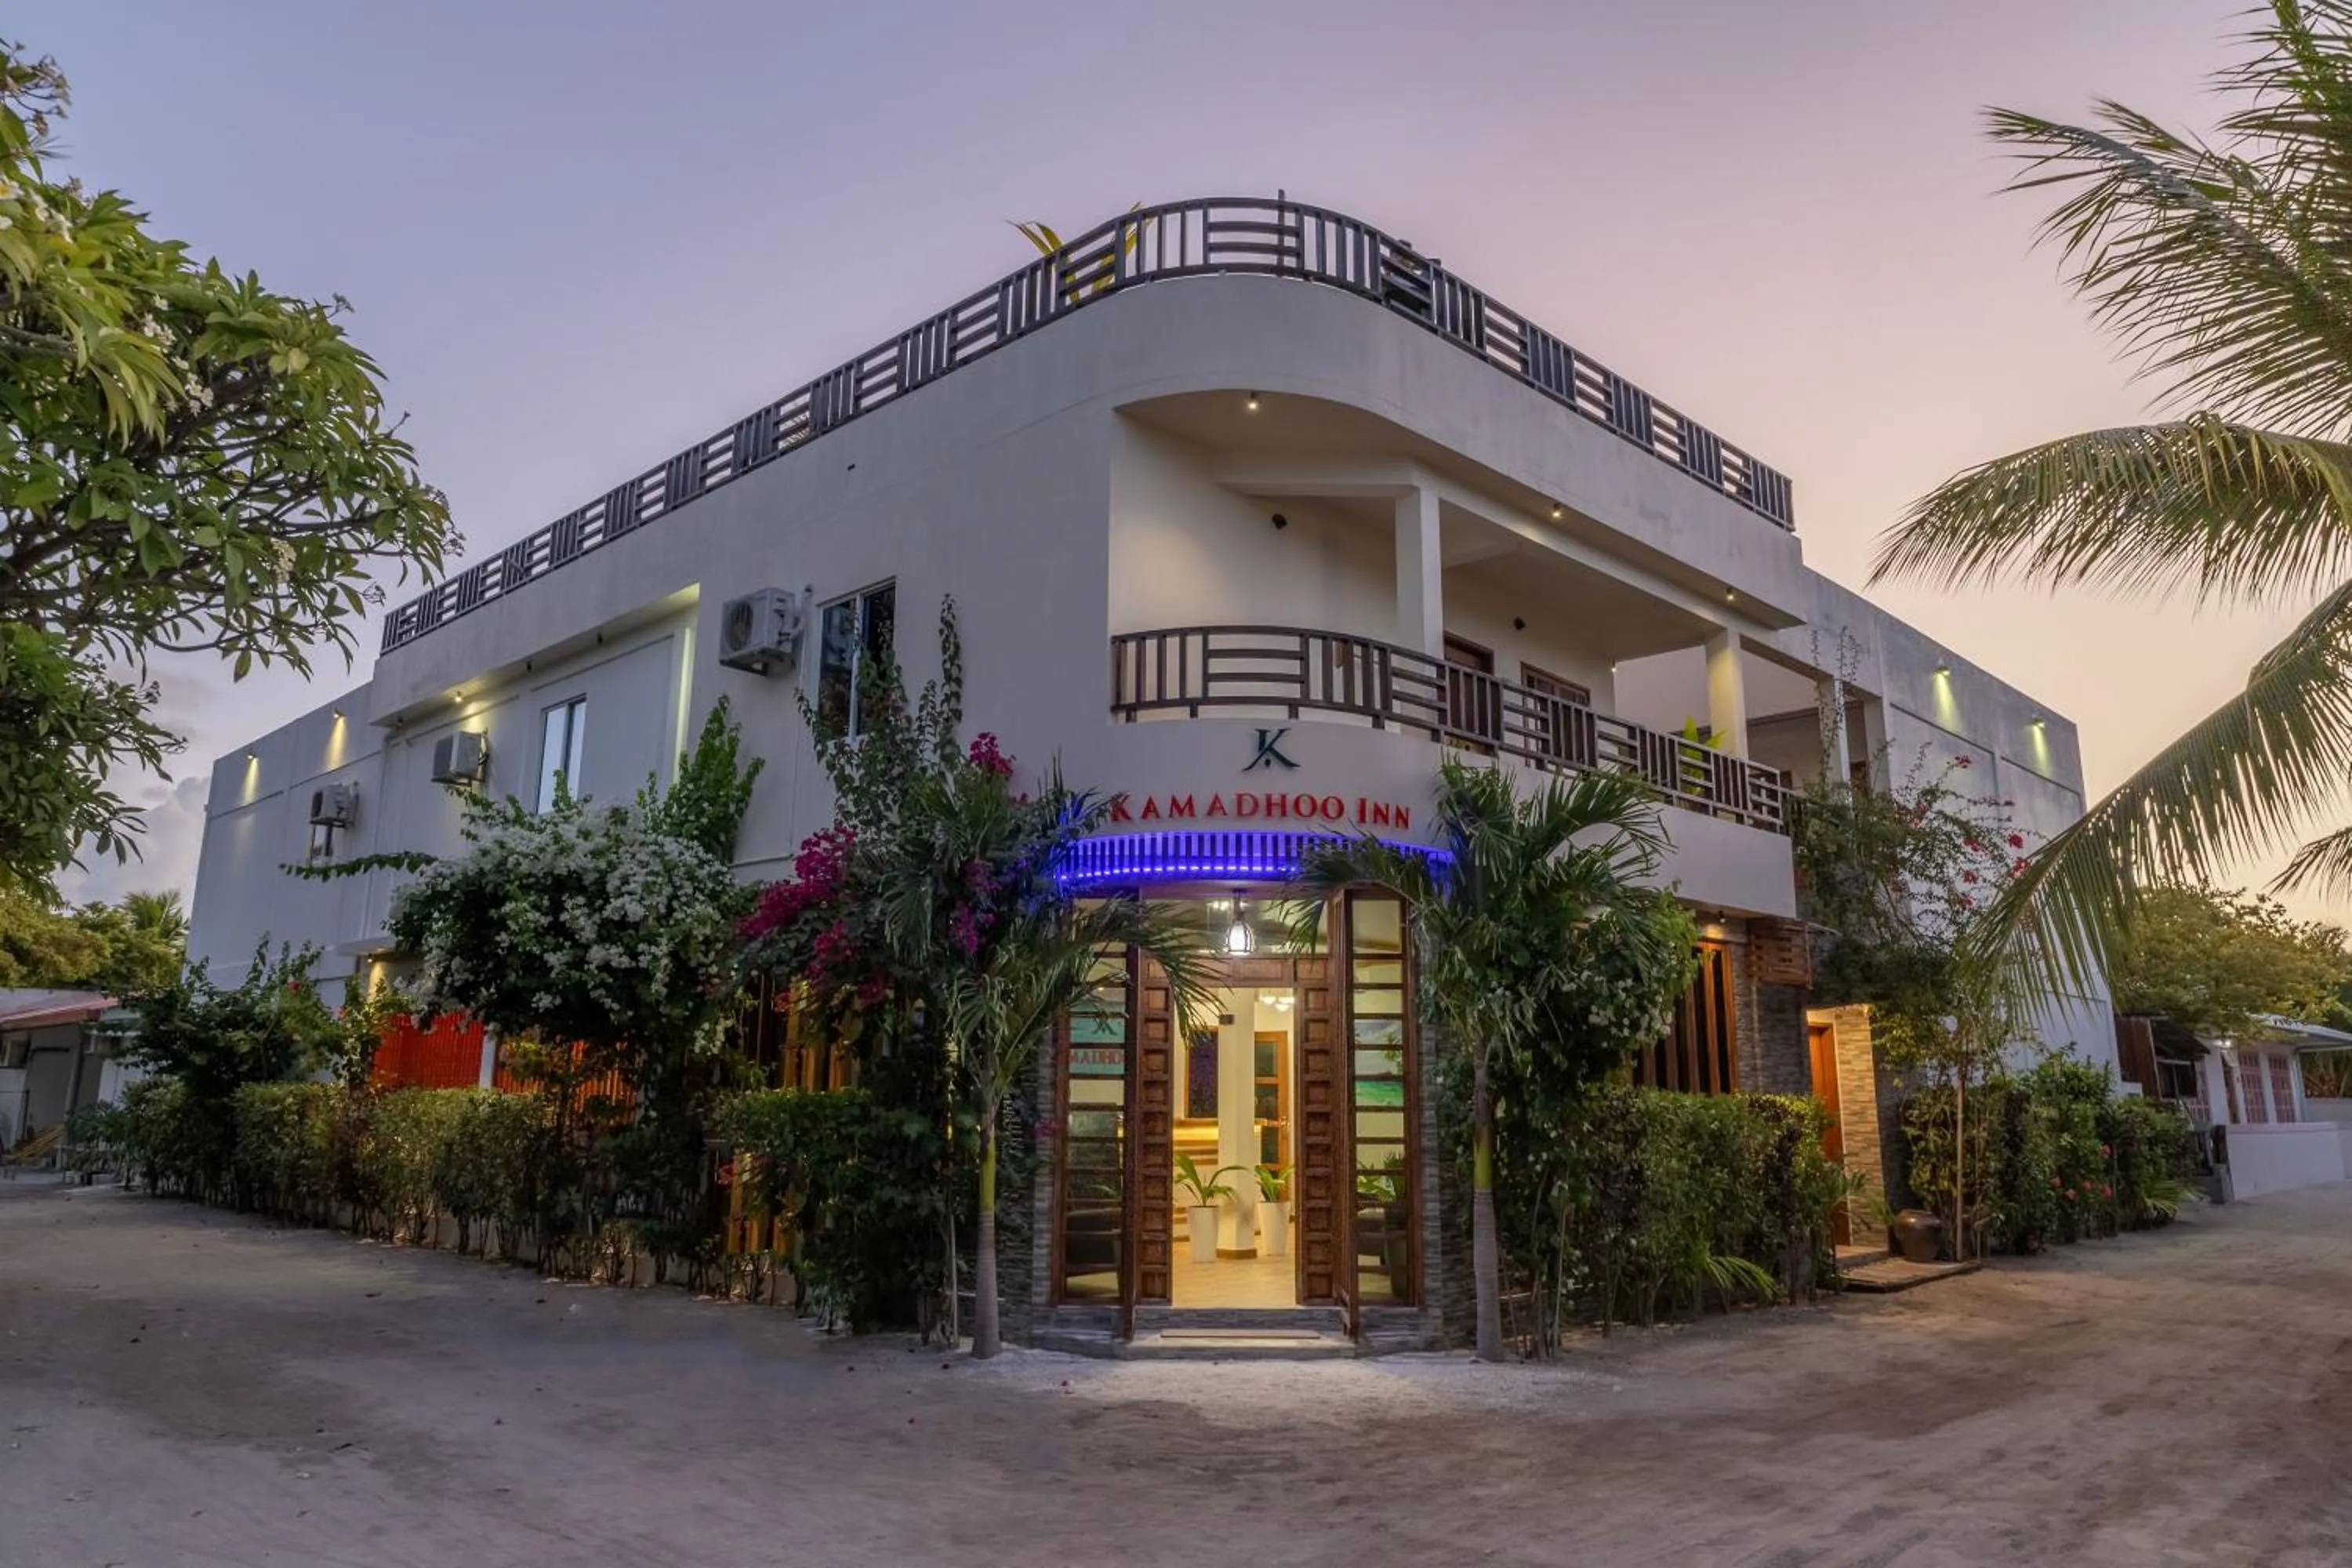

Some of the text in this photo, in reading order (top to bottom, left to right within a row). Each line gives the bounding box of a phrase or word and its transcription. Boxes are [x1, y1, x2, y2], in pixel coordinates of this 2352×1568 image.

[1241, 727, 1301, 772] K
[1110, 791, 1410, 829] KAMADHOO INN
